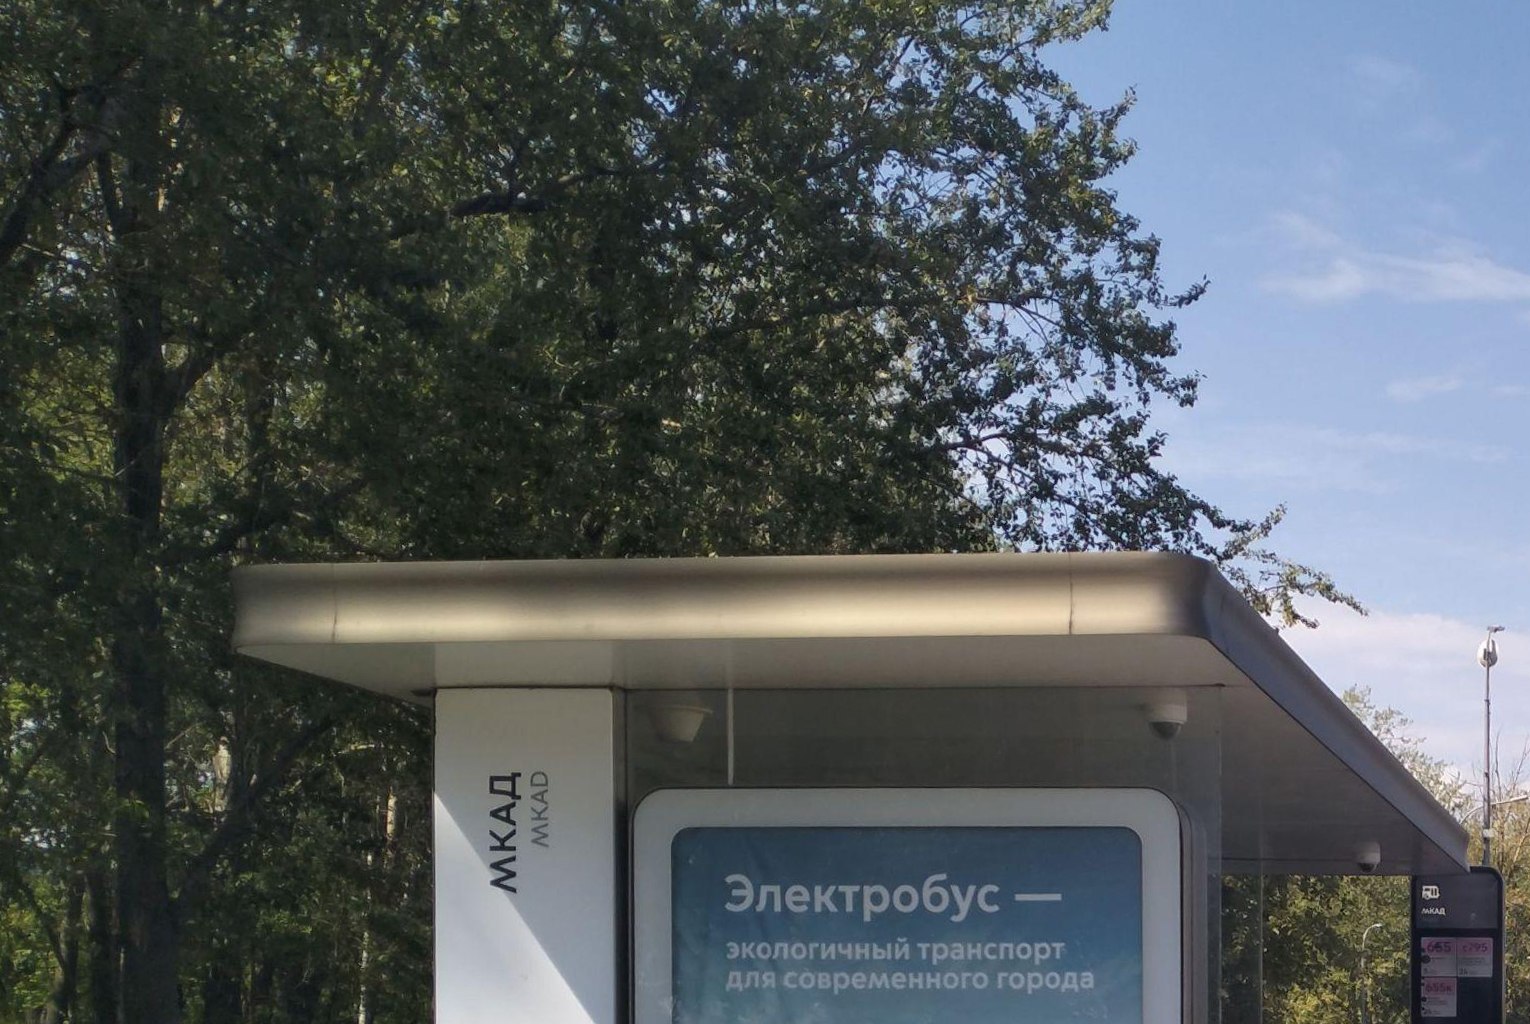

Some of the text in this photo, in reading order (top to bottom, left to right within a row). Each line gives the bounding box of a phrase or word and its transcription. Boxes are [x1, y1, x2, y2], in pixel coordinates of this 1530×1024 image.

[530, 771, 550, 848] MKAD
[489, 772, 522, 894] МКАД
[724, 874, 1000, 922] Электробус
[1421, 907, 1446, 916] МКАД
[725, 938, 1066, 966] экологичный транспорт
[725, 970, 1094, 995] для современного города
